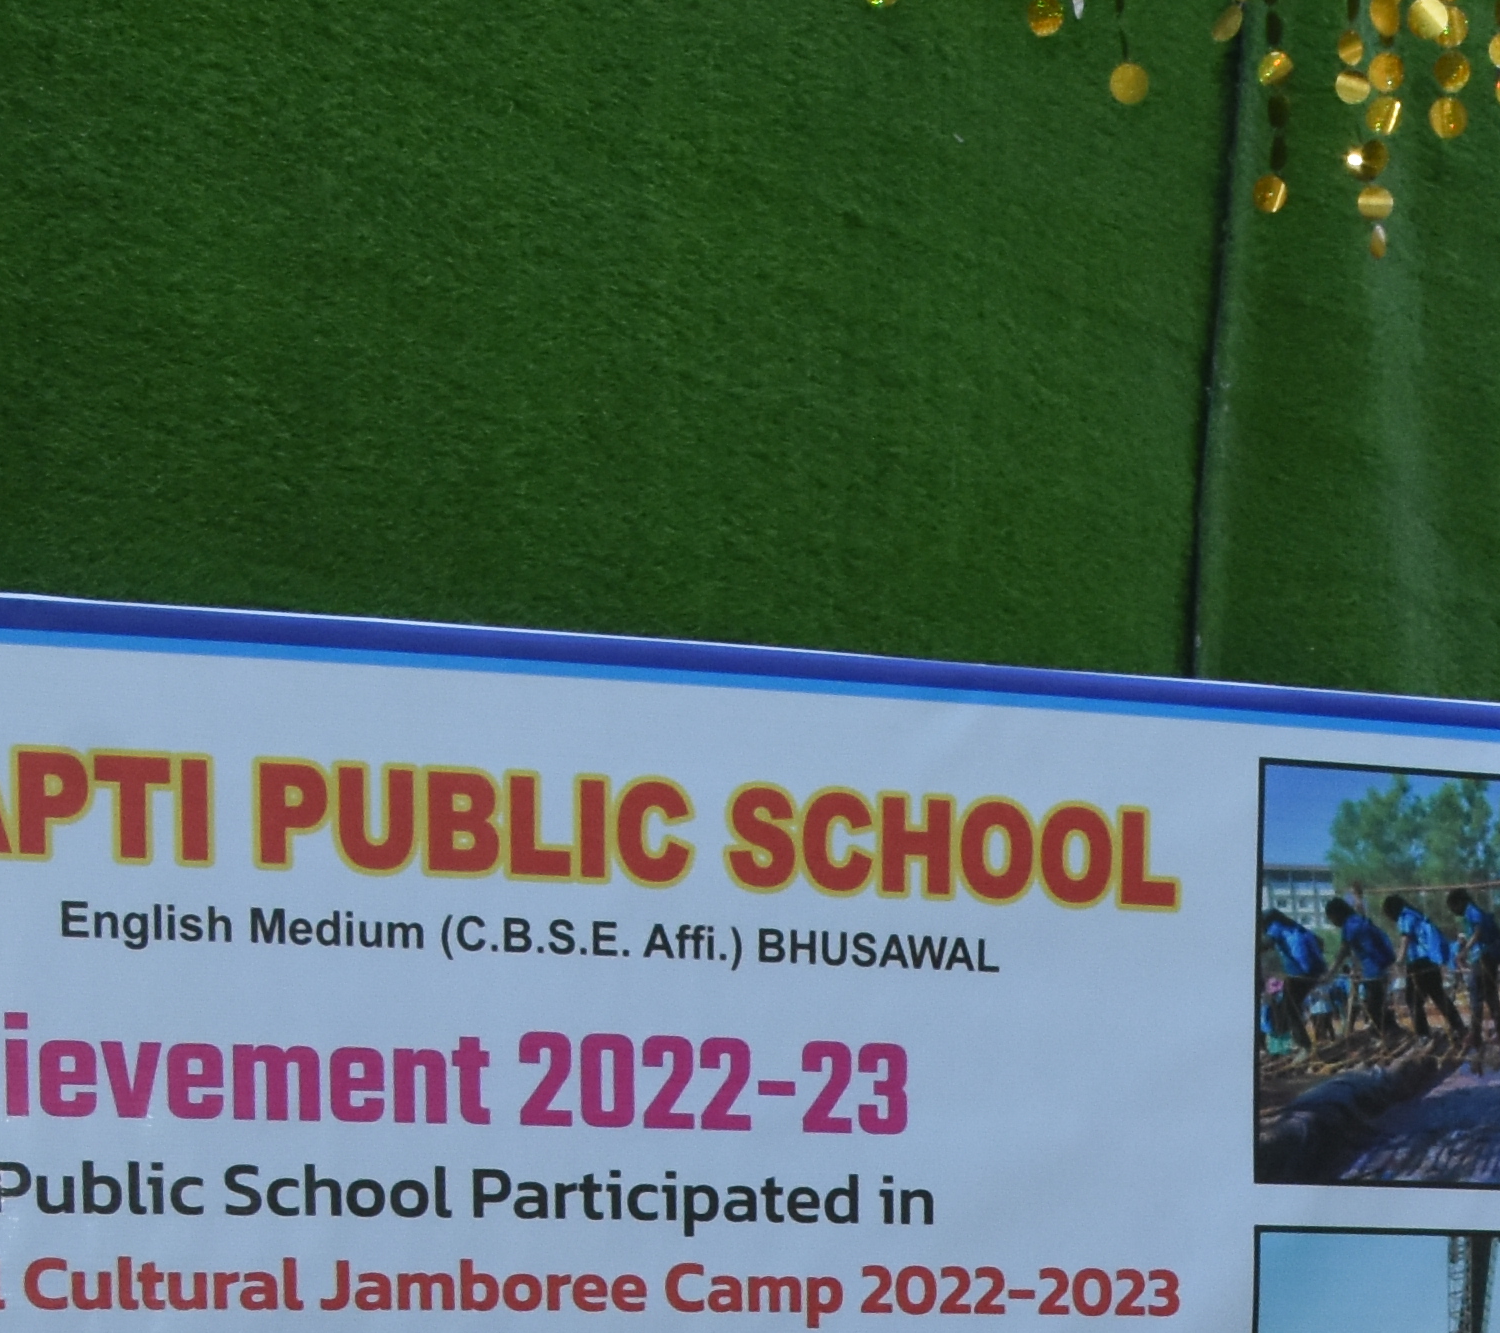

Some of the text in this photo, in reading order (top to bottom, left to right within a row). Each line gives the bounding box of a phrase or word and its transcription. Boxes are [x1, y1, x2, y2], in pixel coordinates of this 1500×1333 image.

[252, 754, 695, 890] PUBLIC
[724, 781, 1182, 914] SCHOOL
[59, 900, 1000, 975] English Medium (C.B.S.E. Affi.) BHUSAWAL
[519, 1031, 909, 1135] 2022-23
[223, 1164, 453, 1219] School
[473, 1167, 860, 1237] Participated
[879, 1173, 936, 1226] in
[24, 1257, 304, 1313] Cultural
[320, 1258, 648, 1314] Jamboree
[665, 1263, 845, 1329] Camp
[859, 1265, 1181, 1318] 2022-2023
